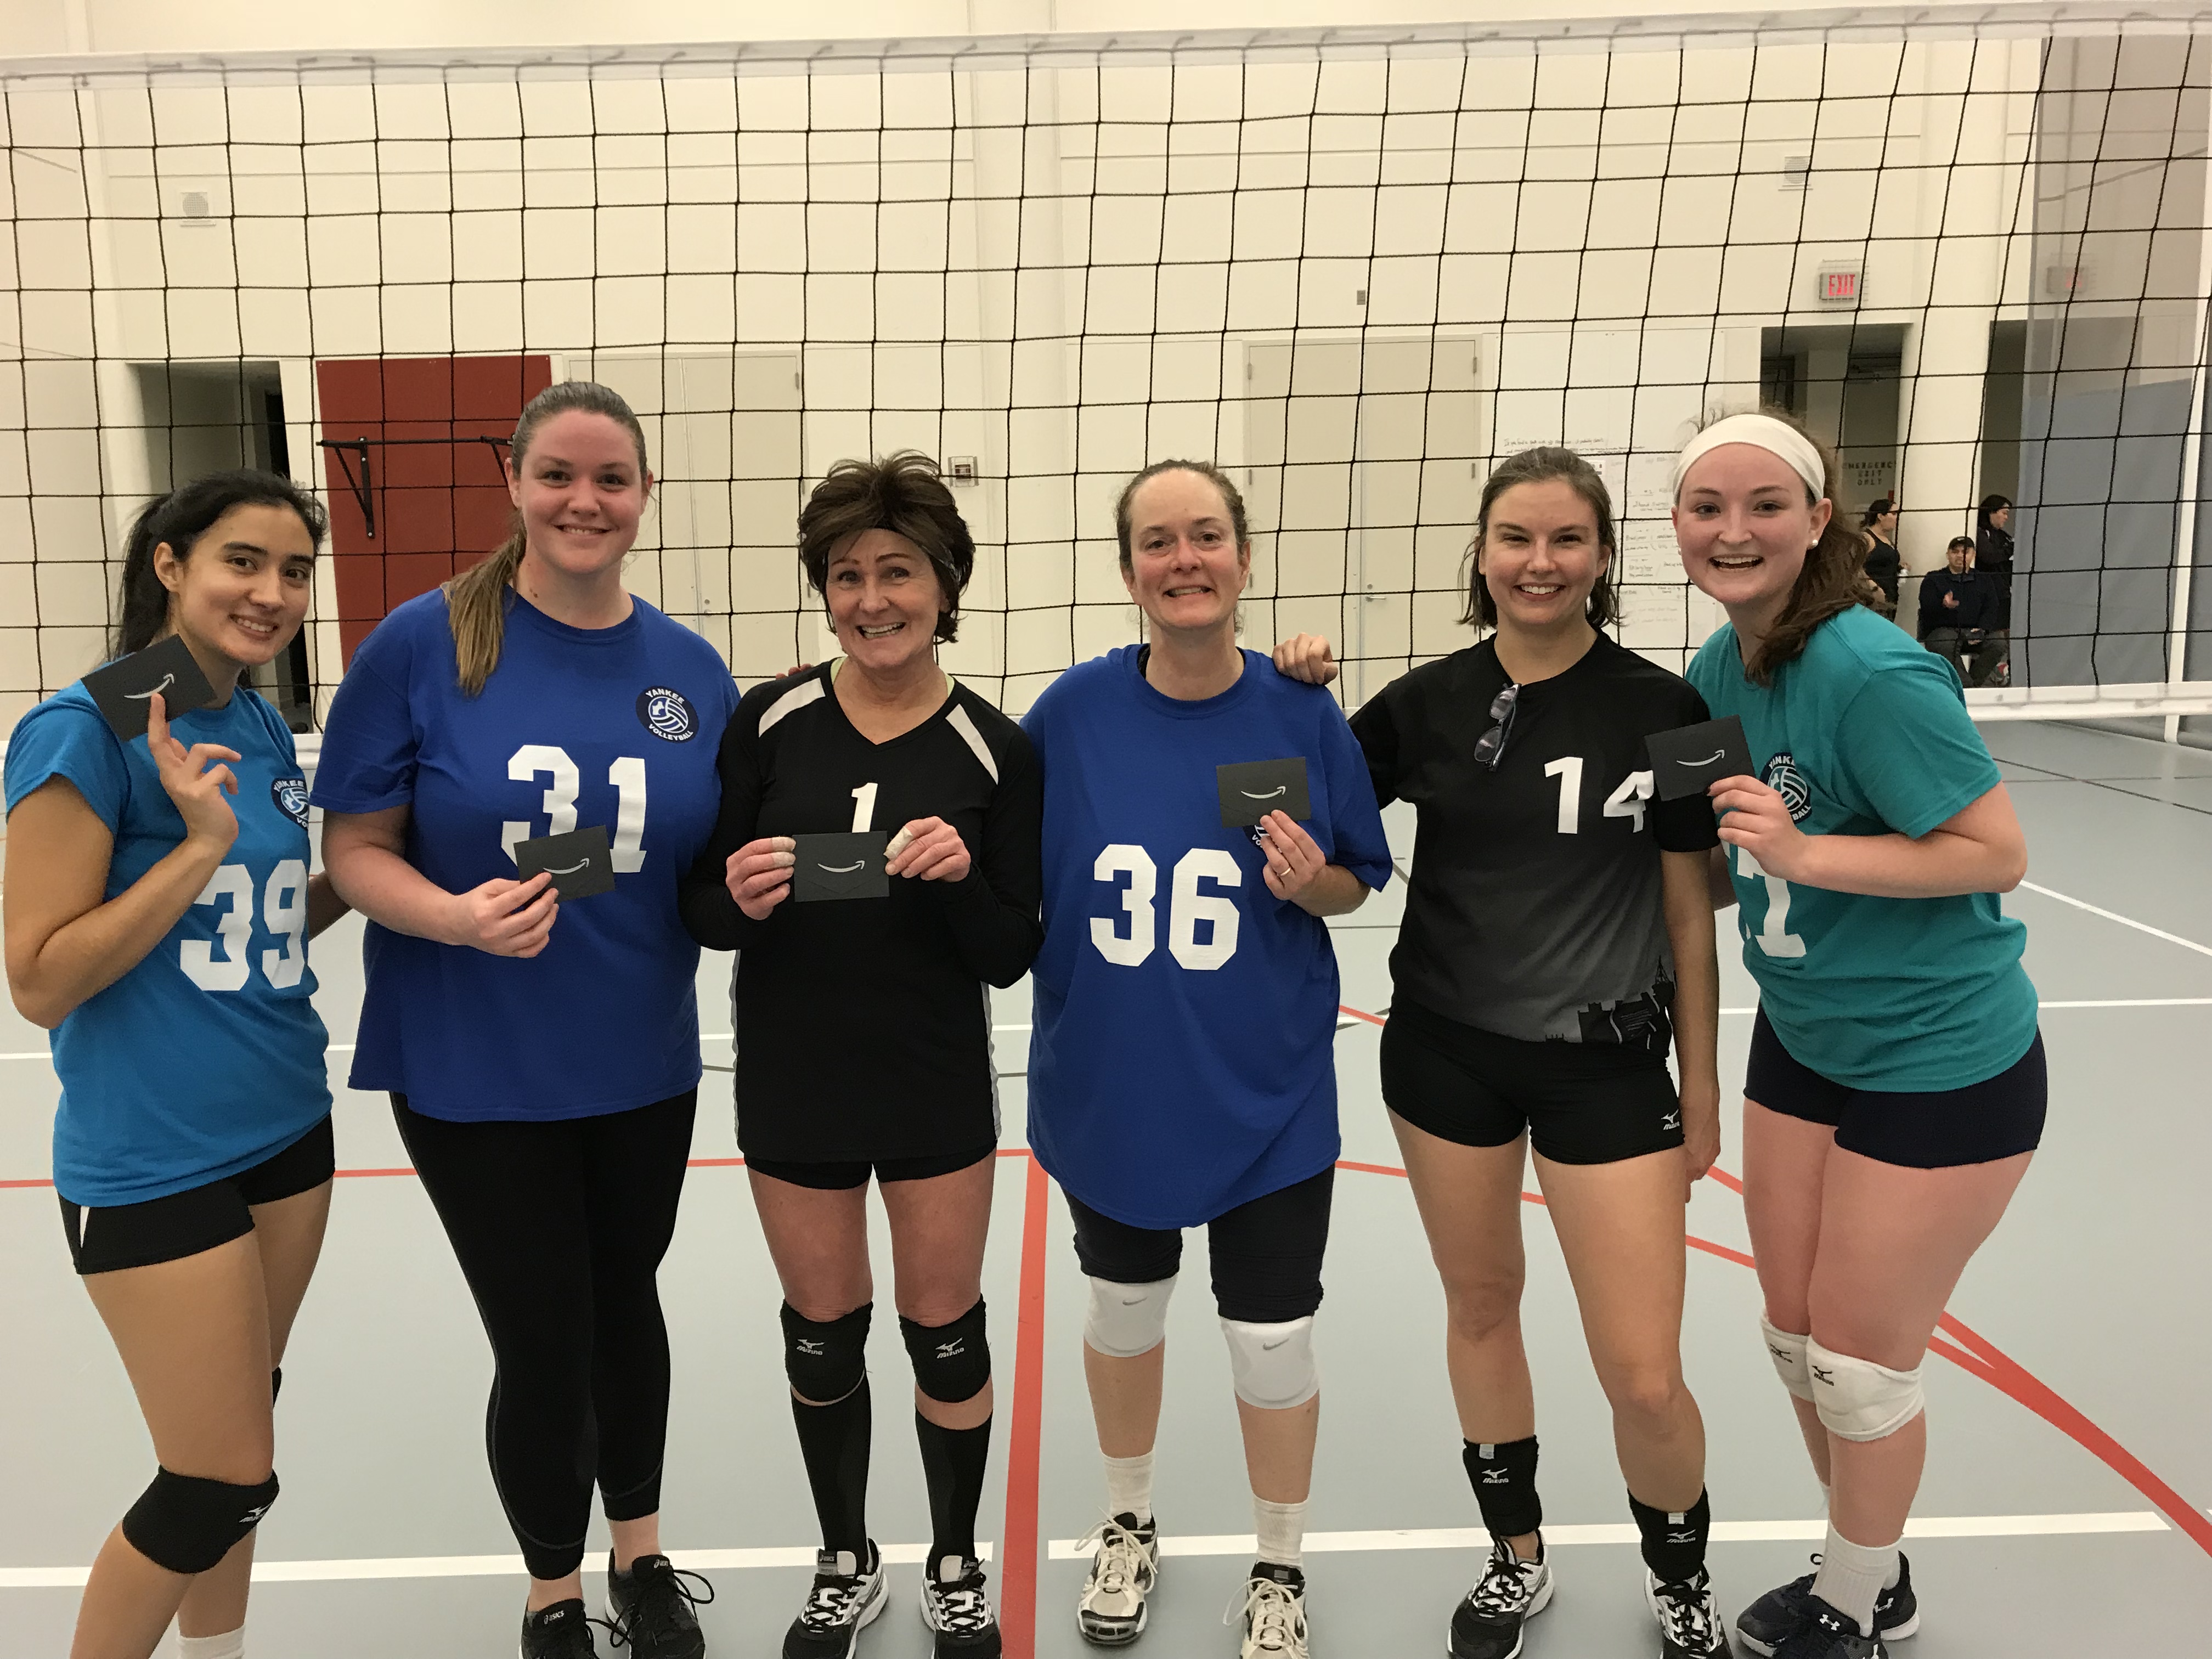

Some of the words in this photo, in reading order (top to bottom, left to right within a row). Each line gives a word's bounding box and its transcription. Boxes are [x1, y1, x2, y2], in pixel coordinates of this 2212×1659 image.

[1829, 274, 1855, 296] EXIT
[645, 688, 685, 704] YANKEE
[648, 724, 694, 741] VOLLEYBALL
[1768, 755, 1795, 770] YANK
[501, 744, 647, 873] 31
[851, 782, 878, 833] 1
[1544, 756, 1654, 834] 14
[180, 859, 308, 991] 39
[1090, 844, 1242, 970] 36
